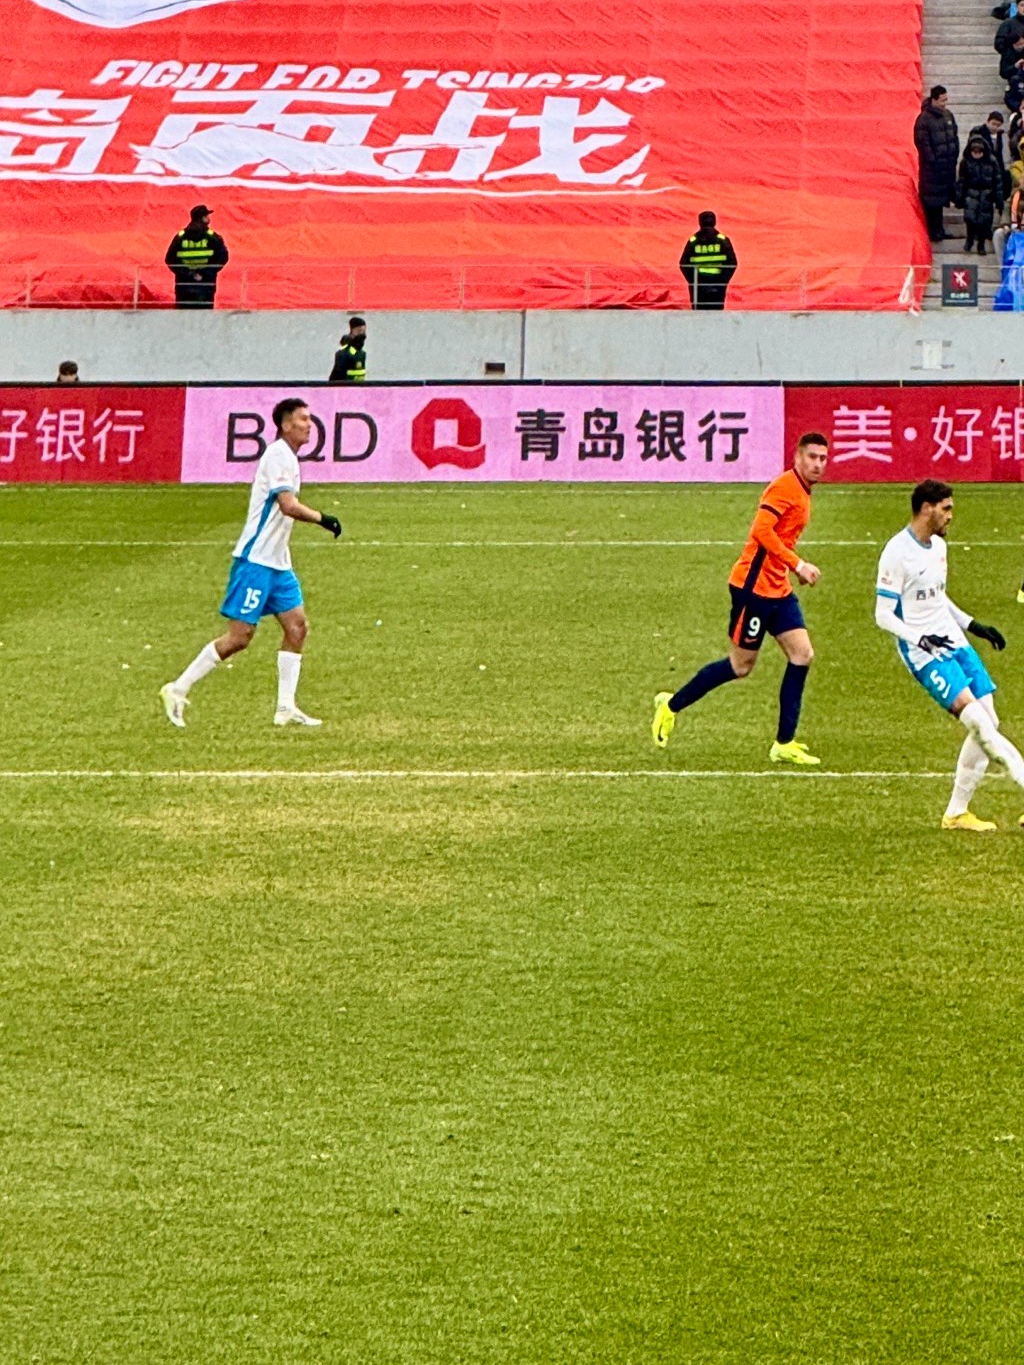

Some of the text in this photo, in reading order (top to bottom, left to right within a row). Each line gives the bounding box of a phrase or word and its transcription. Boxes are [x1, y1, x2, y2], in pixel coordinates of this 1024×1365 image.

[90, 58, 667, 94] FIGHT FOR TSINGTAO
[514, 407, 749, 462] 青岛银行
[244, 587, 262, 610] 15
[748, 616, 761, 637] 9
[929, 669, 947, 691] 5
